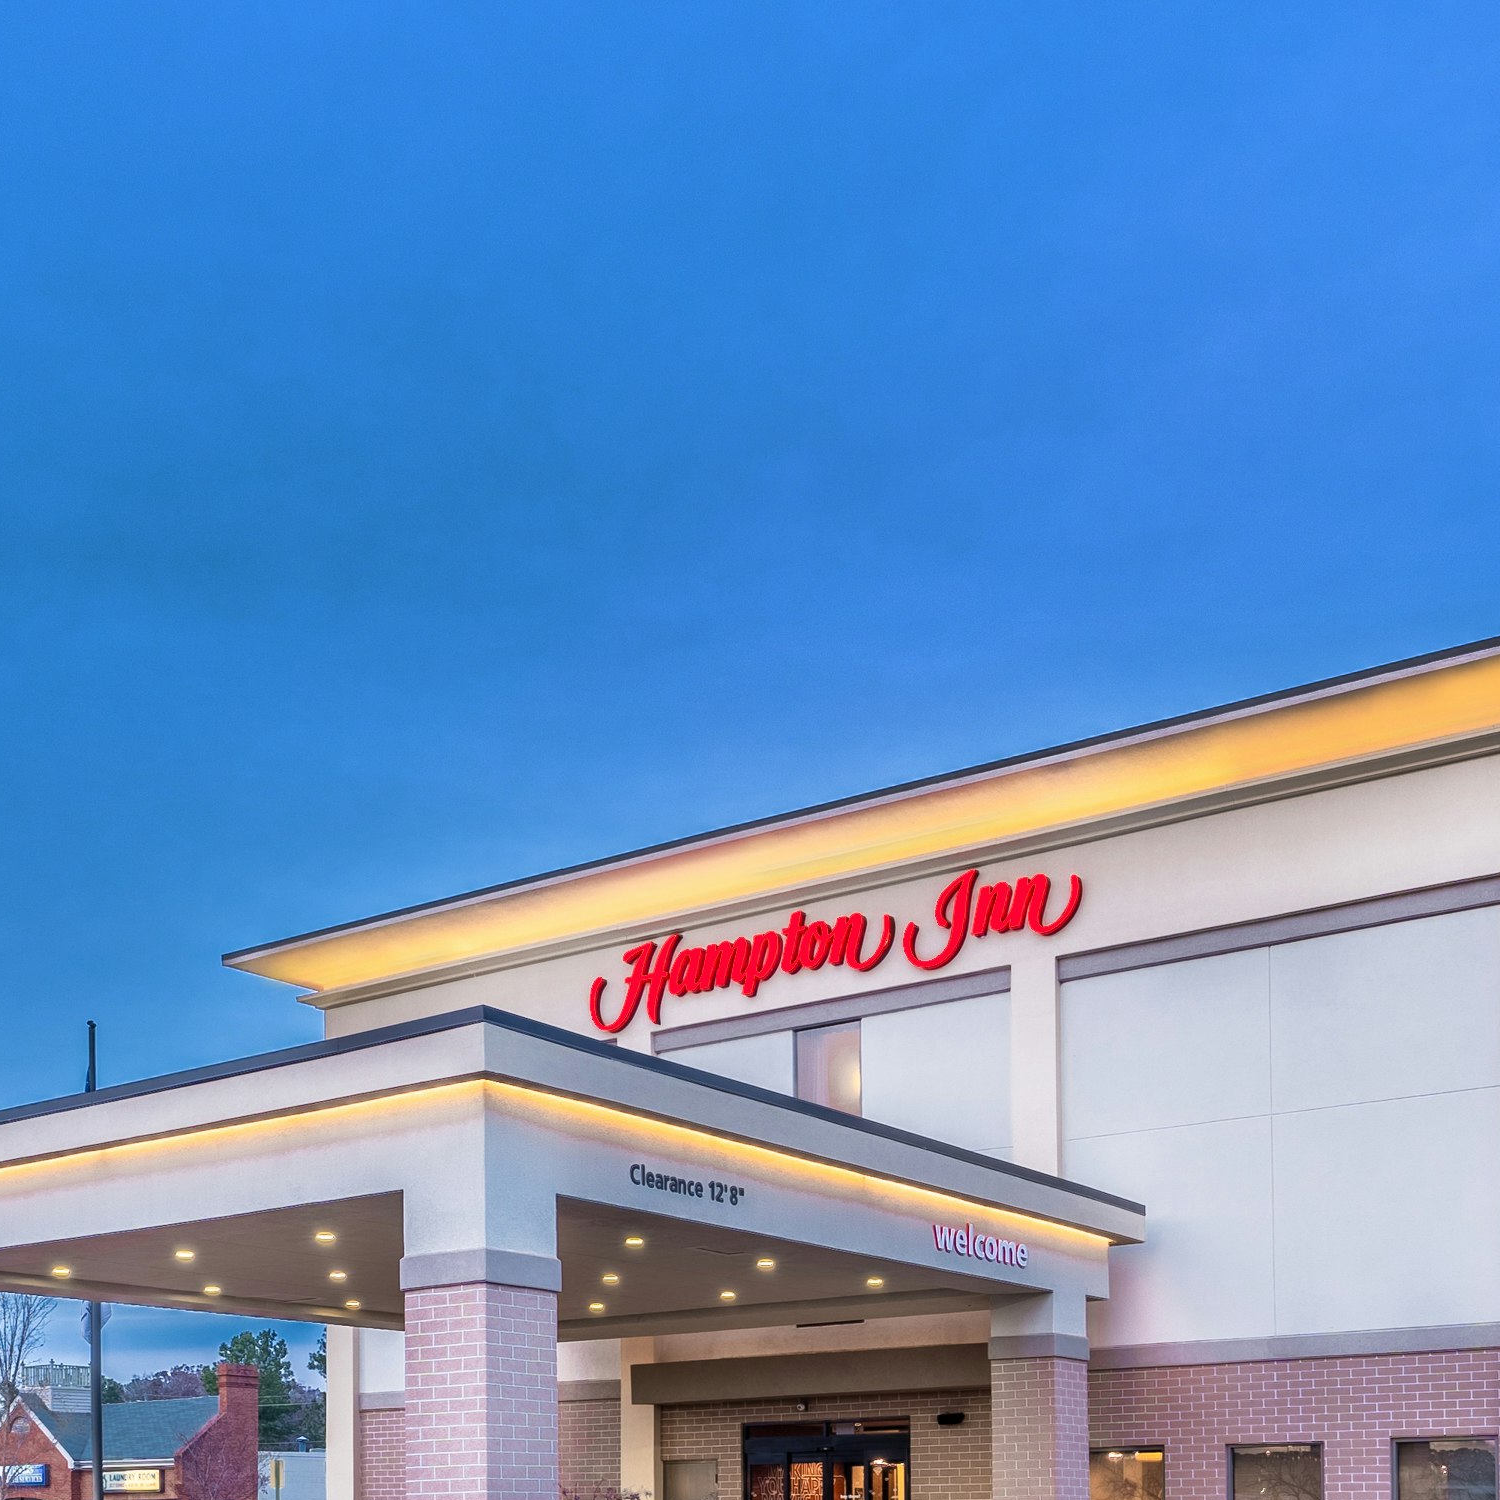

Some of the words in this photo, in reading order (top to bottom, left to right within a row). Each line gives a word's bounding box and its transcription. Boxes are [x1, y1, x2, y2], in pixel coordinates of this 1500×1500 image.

[589, 910, 894, 1032] Hampton
[903, 868, 1082, 970] Inn
[629, 1163, 704, 1198] Clearance
[932, 1223, 1029, 1269] welcome
